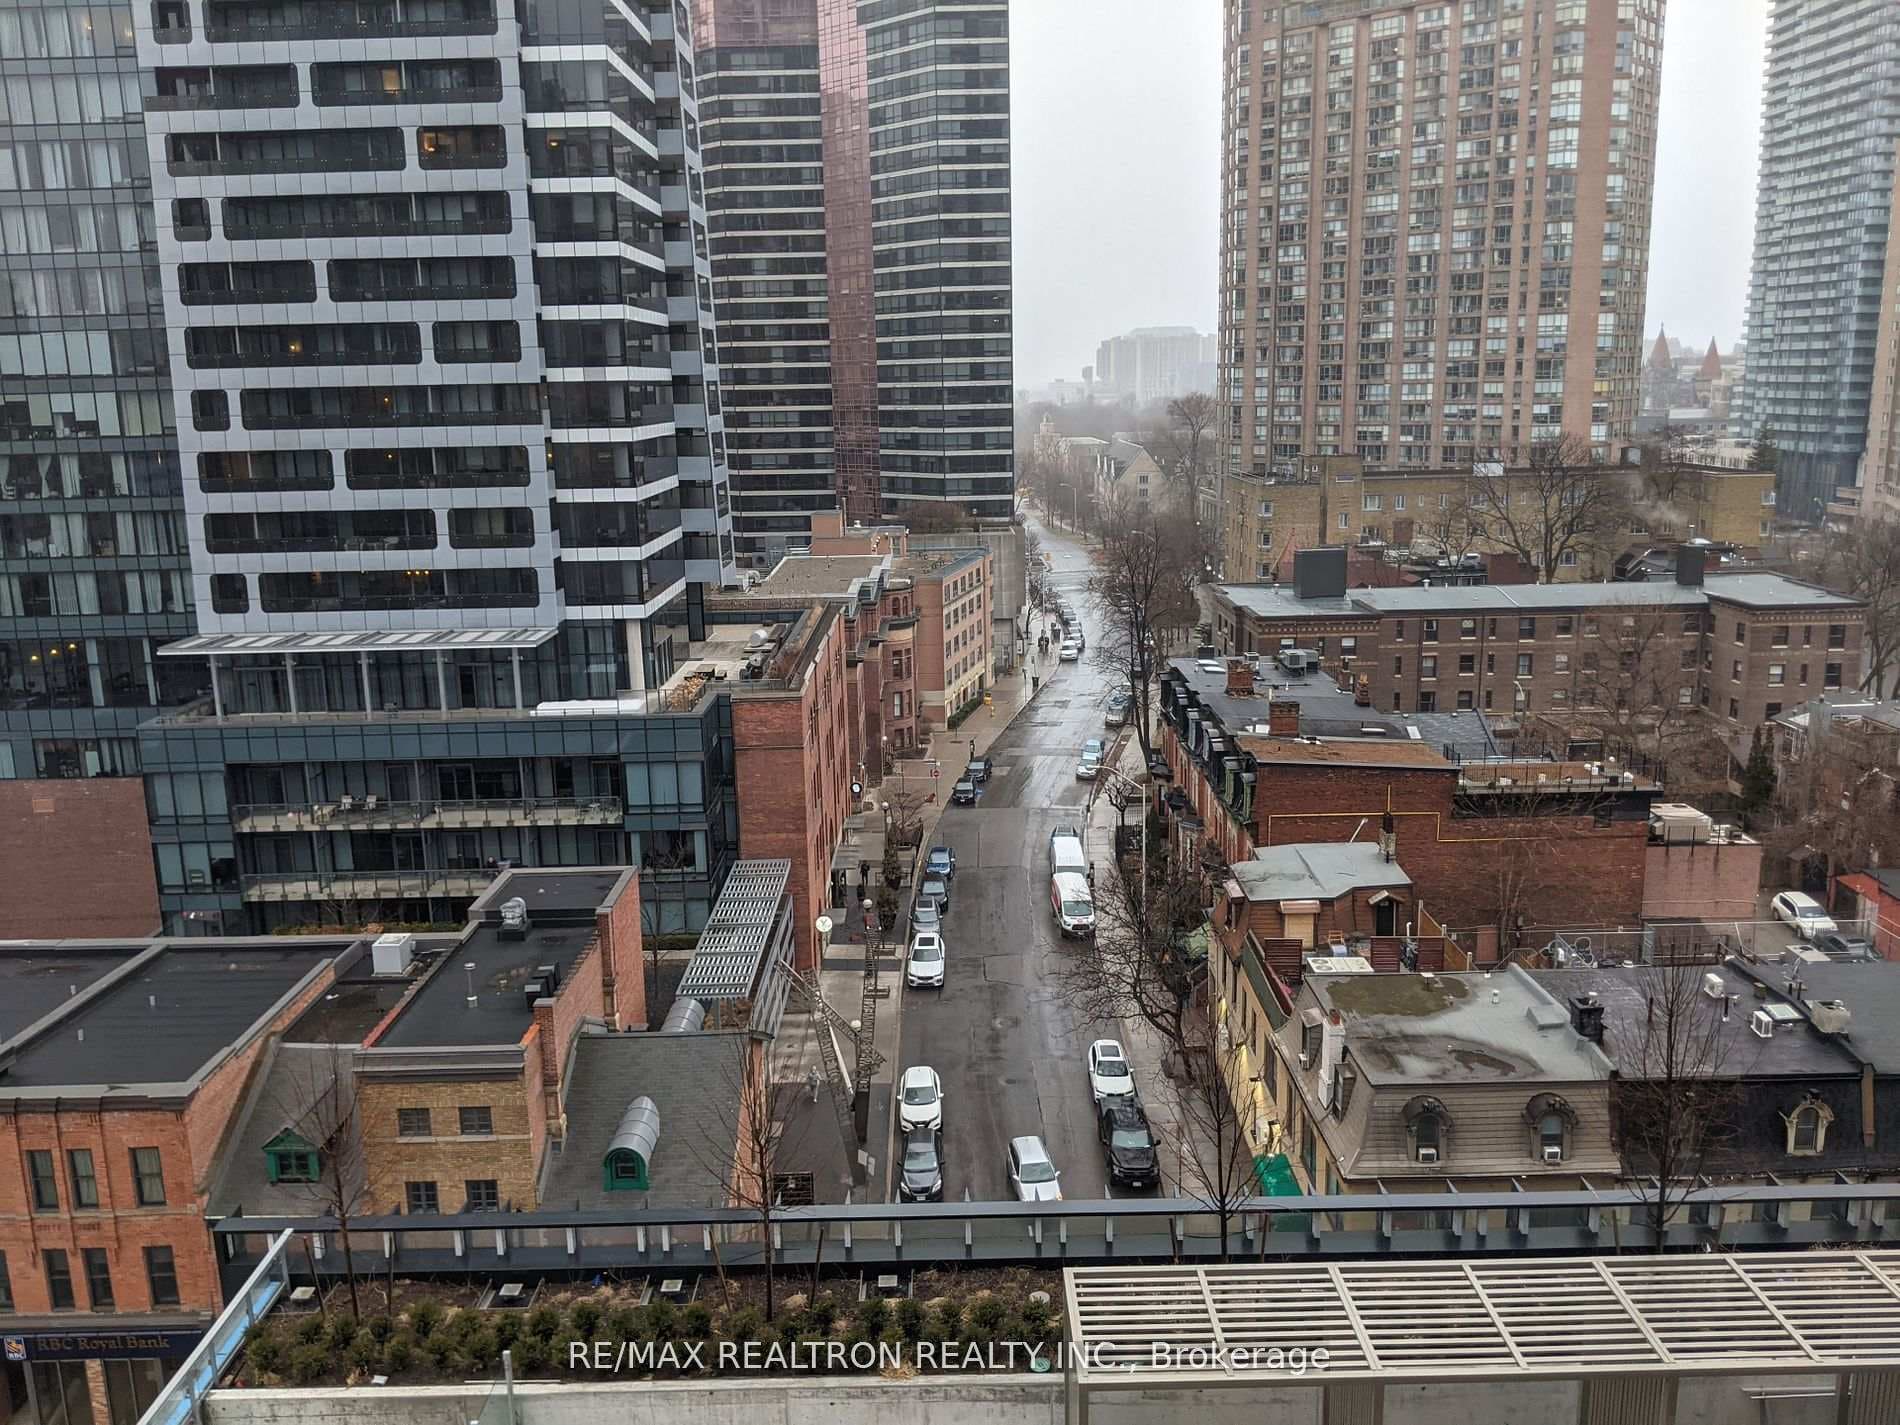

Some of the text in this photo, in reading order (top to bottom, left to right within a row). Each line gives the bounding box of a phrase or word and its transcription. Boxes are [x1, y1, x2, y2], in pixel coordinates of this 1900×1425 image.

[38, 1336, 171, 1351] RBC Royal Bank
